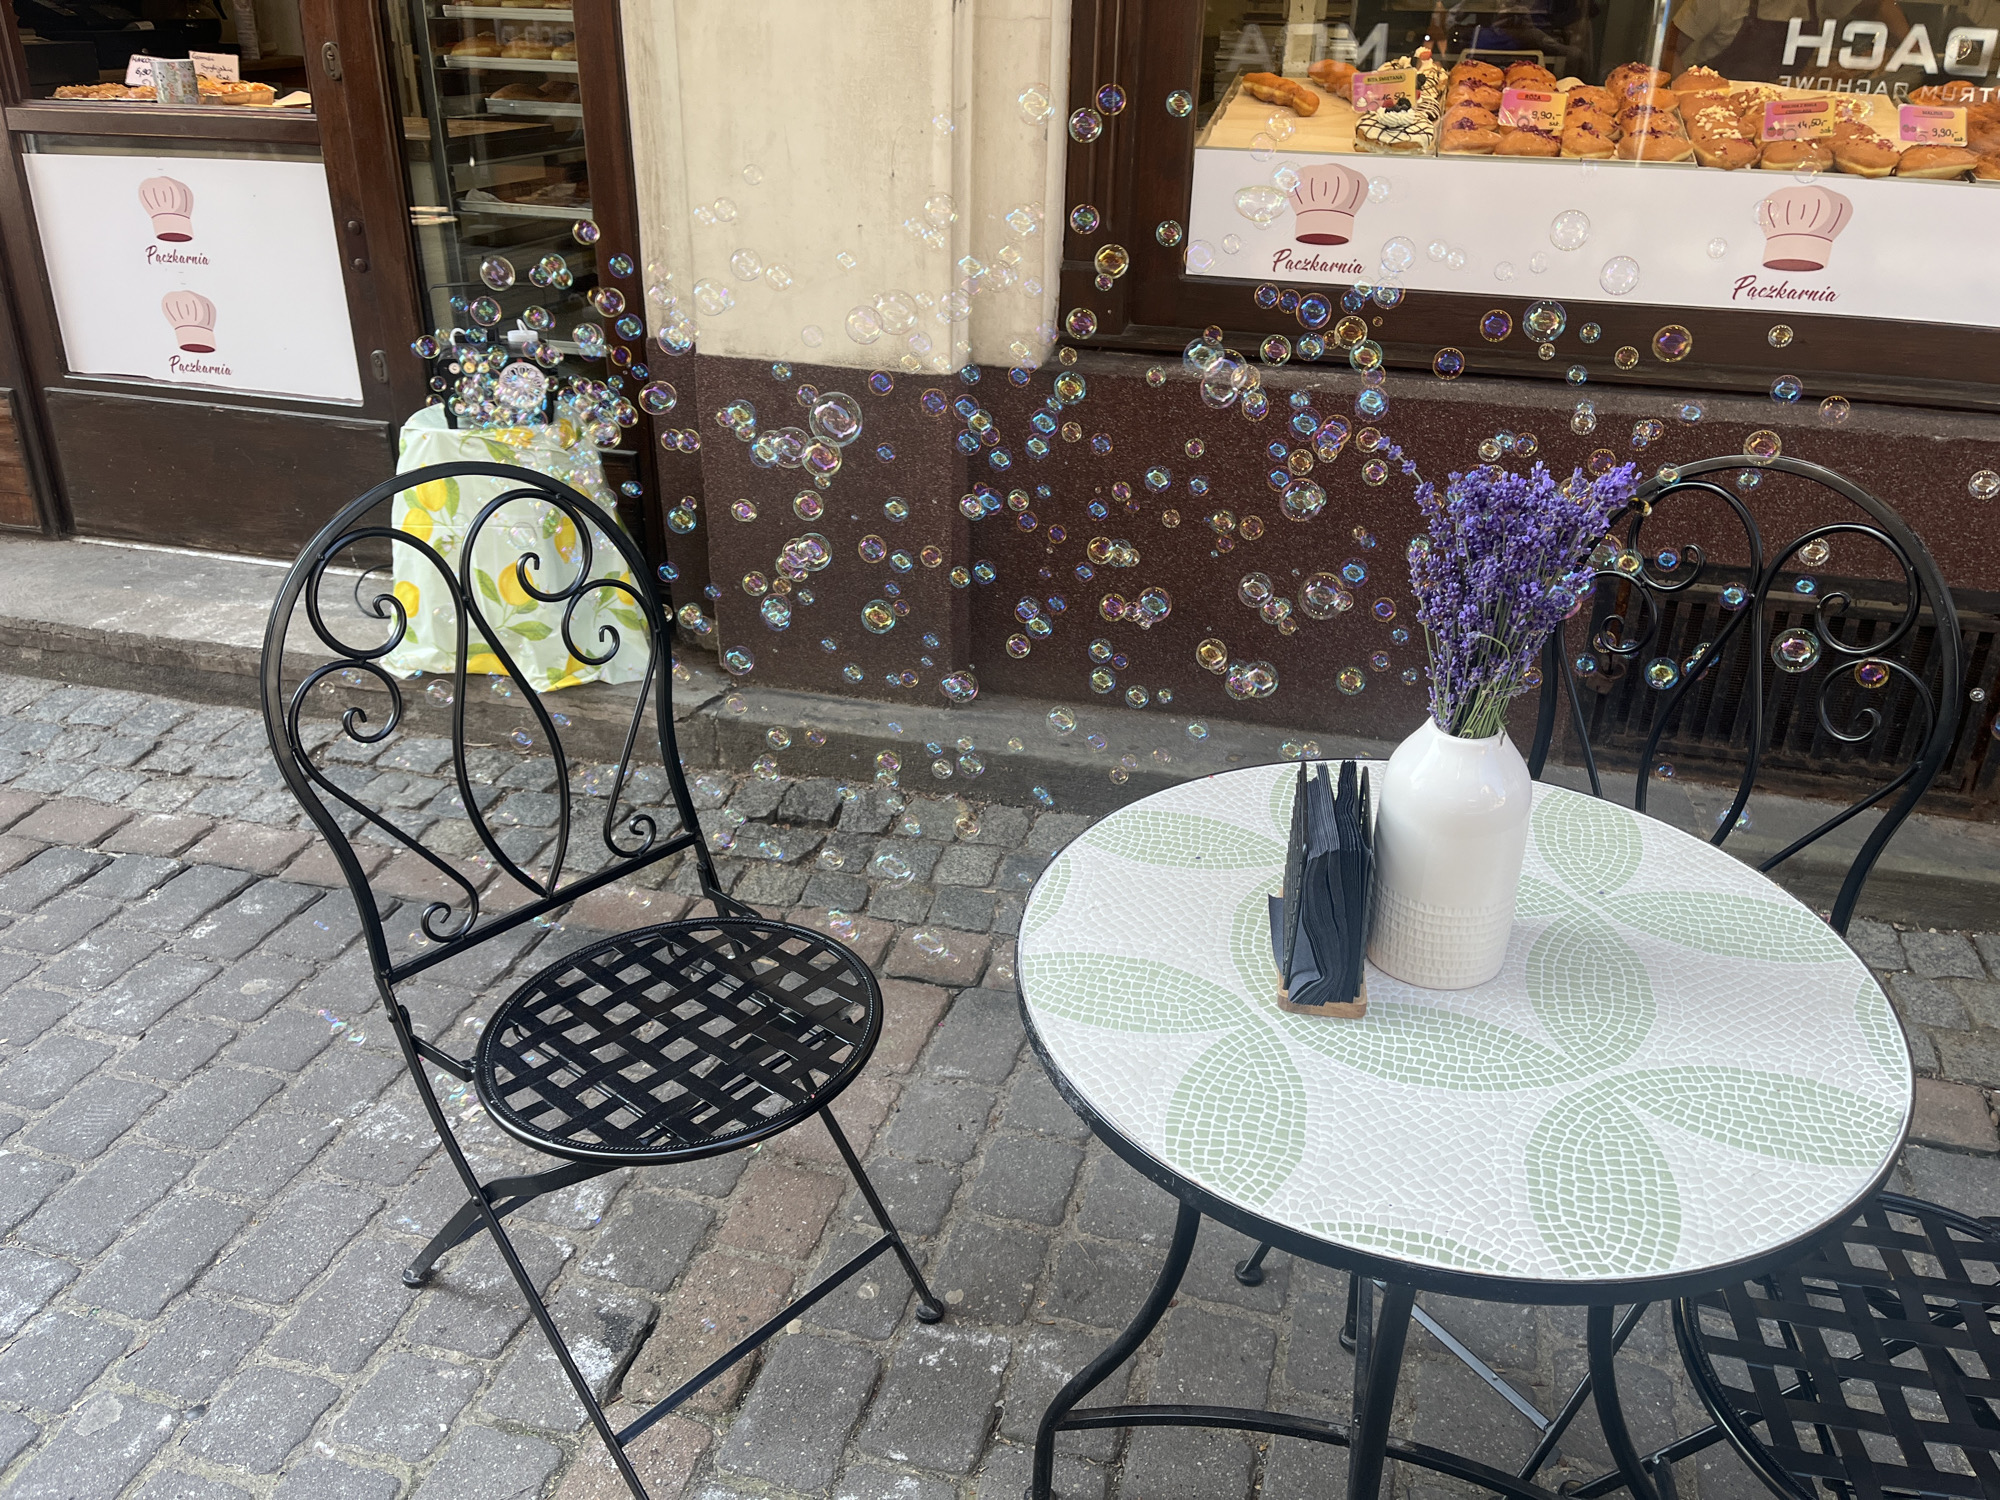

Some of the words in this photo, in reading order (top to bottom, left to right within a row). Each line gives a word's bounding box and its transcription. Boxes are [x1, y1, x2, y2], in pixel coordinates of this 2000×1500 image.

[145, 245, 211, 266] Pączkarnia
[1272, 248, 1367, 275] Pączkarnia
[1732, 274, 1841, 303] Pączkarnia
[168, 355, 234, 376] Pączkarnia
